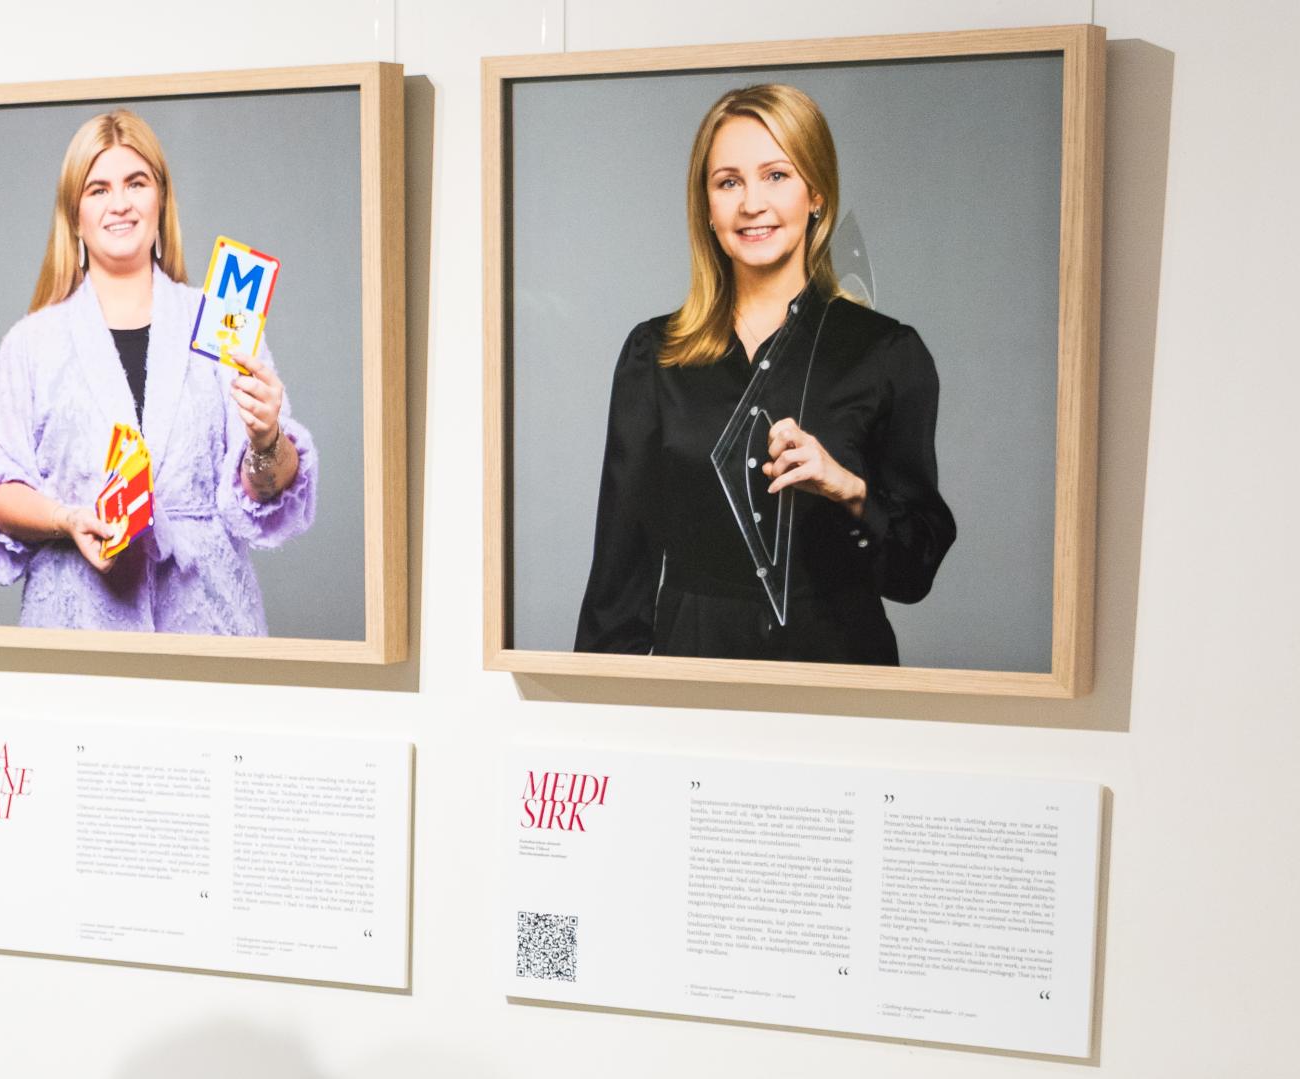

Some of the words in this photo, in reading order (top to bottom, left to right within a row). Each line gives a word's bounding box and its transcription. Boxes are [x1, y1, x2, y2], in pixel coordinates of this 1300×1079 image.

[217, 253, 265, 311] M
[520, 770, 611, 806] MEIDI
[520, 797, 588, 832] SIRK
